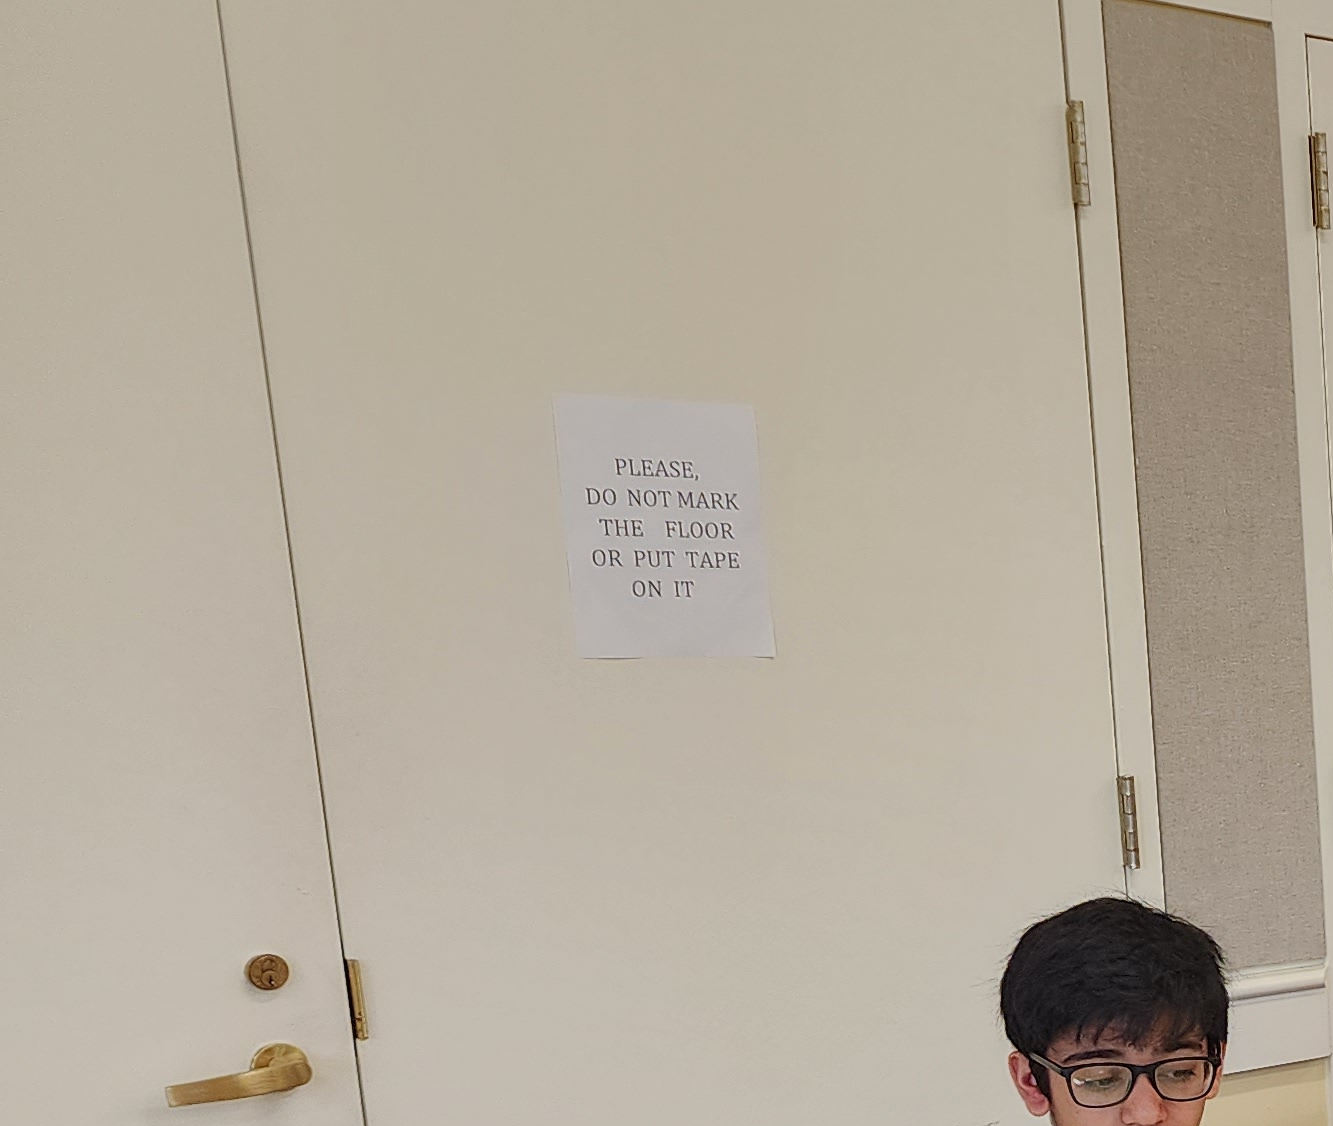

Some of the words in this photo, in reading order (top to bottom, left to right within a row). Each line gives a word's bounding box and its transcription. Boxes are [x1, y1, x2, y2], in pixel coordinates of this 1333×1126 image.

[614, 457, 699, 481] PLEASE,
[585, 487, 617, 506] DO
[627, 489, 672, 508] NOT
[677, 491, 740, 511] MARK
[598, 518, 644, 538] THE
[664, 520, 735, 540] FLOOR
[592, 549, 624, 568] OR
[633, 550, 676, 568] PUT
[685, 551, 740, 569] TAPE
[632, 580, 662, 598] ON
[673, 581, 695, 598] IT
